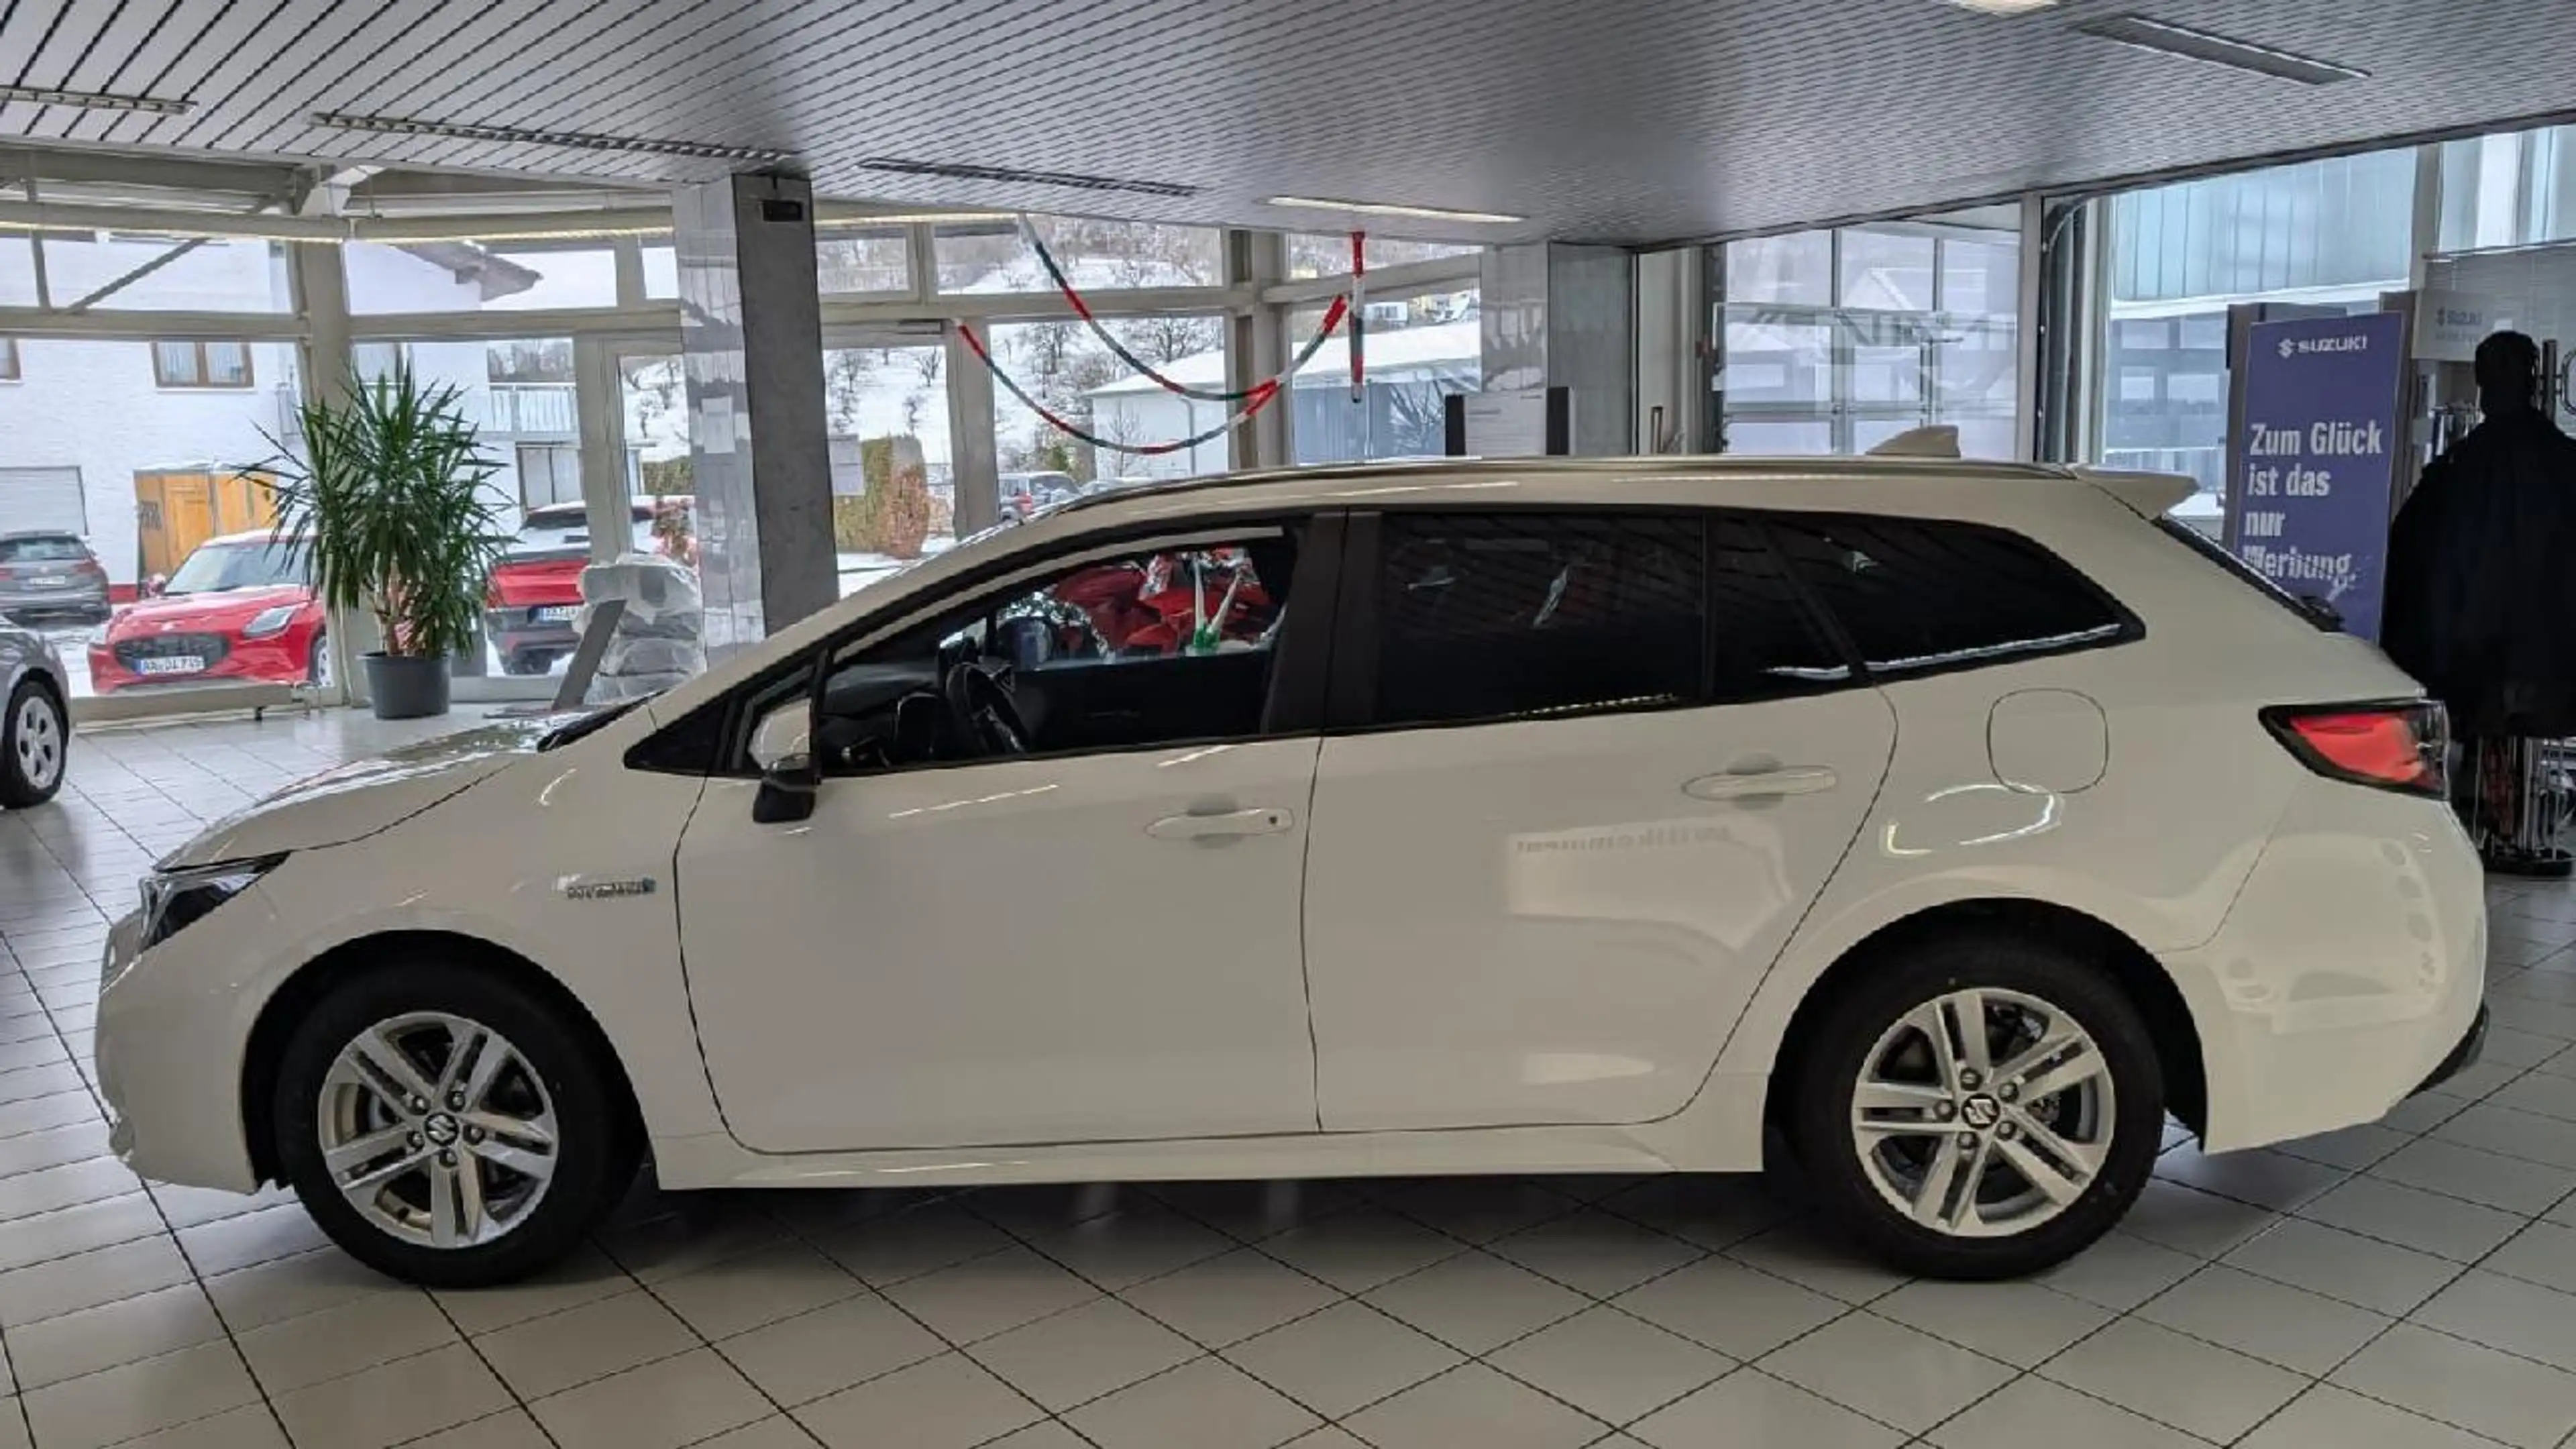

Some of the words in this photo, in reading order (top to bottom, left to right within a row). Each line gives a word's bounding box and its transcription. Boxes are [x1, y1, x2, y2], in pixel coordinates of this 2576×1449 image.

[2298, 334, 2368, 354] SUZUKI
[2249, 423, 2302, 456] Zum
[2310, 419, 2383, 455] Glück
[2247, 462, 2279, 496] ist
[2286, 462, 2332, 496] das
[2245, 511, 2286, 537] nur
